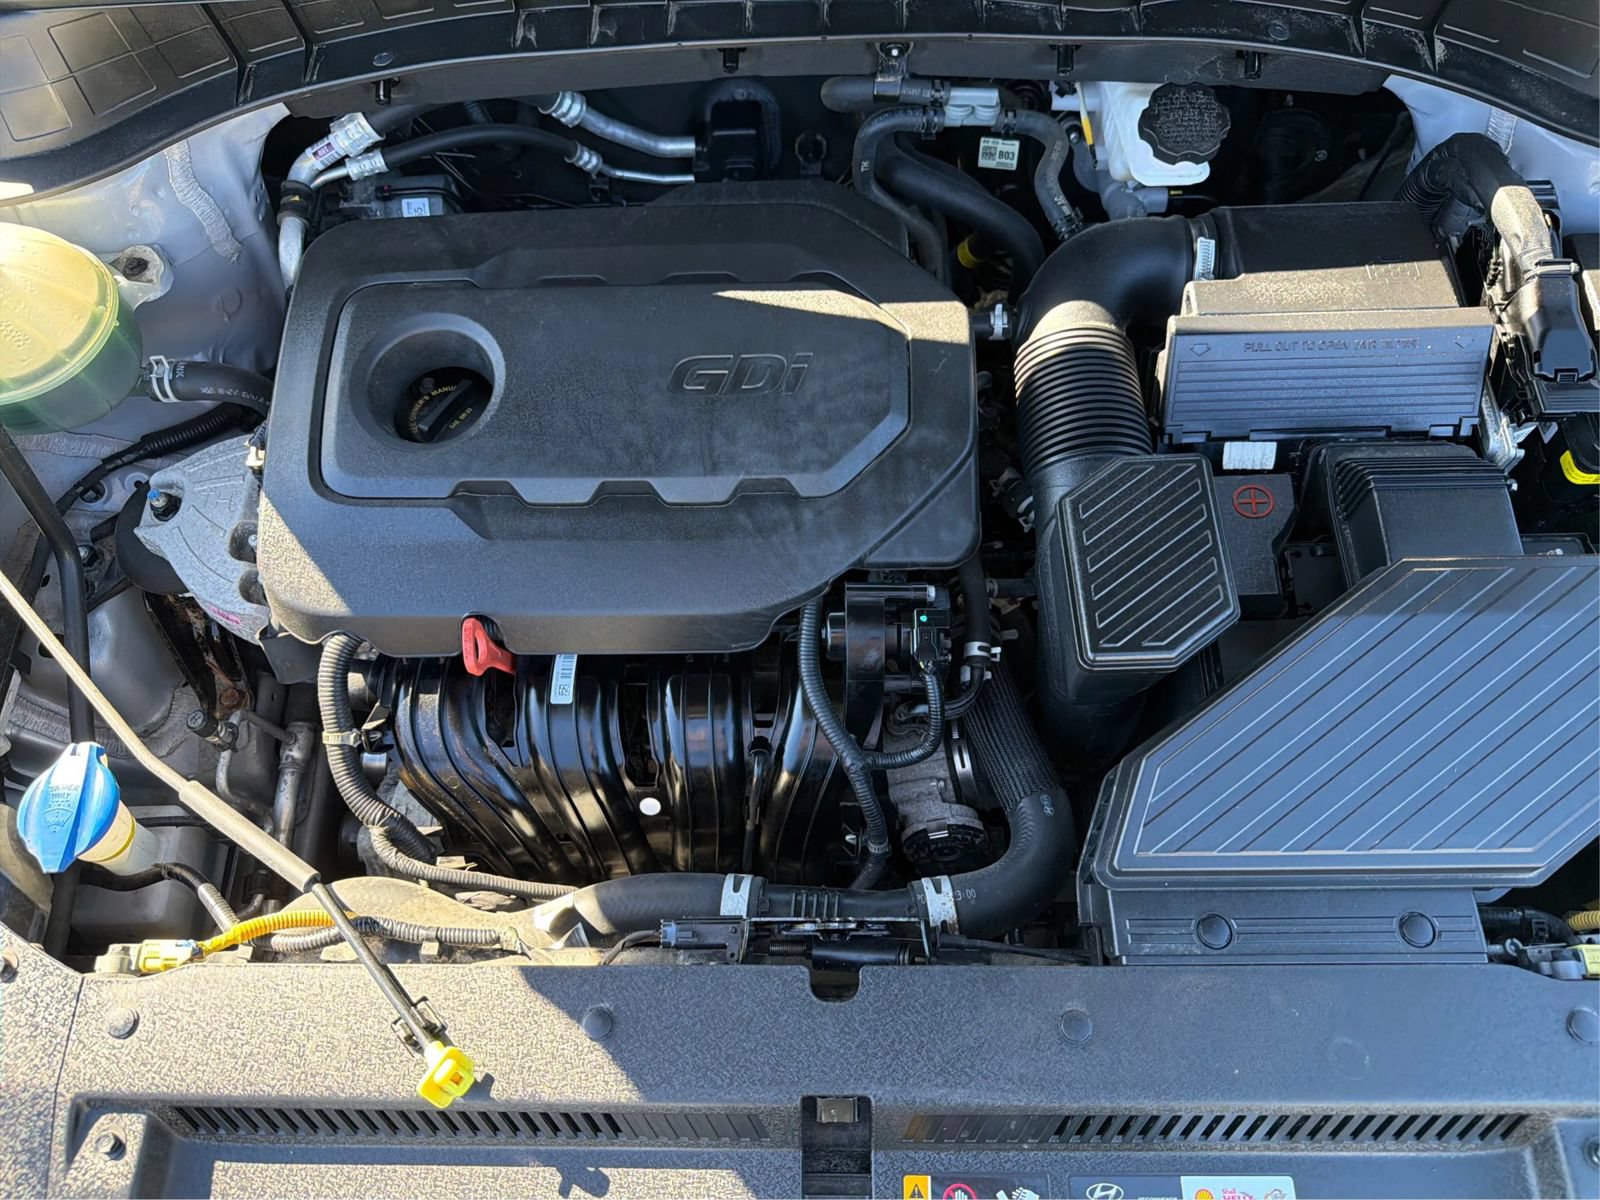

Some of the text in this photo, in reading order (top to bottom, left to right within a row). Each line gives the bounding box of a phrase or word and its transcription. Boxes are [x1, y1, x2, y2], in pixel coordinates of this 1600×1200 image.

[998, 150, 1015, 161] B03
[1244, 342, 1273, 352] PULL
[1275, 341, 1299, 351] OUT
[1302, 340, 1315, 351] TO
[671, 352, 813, 395] GDi
